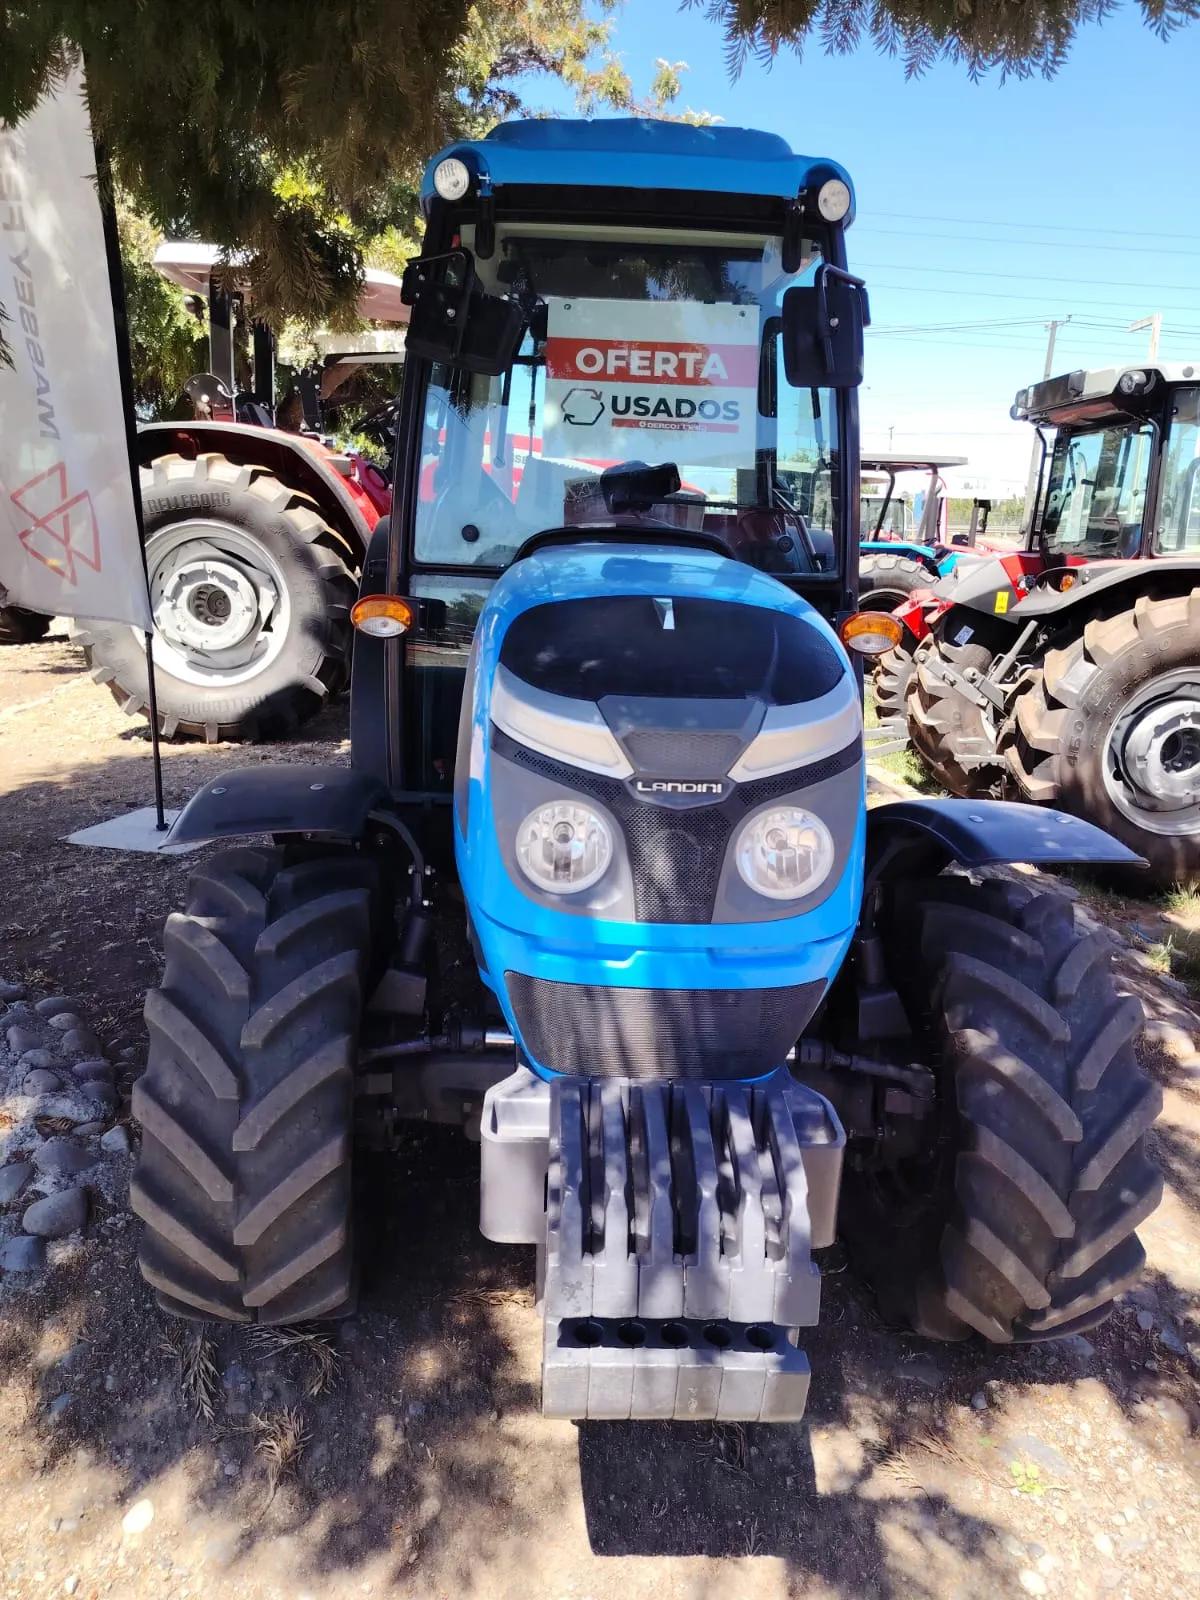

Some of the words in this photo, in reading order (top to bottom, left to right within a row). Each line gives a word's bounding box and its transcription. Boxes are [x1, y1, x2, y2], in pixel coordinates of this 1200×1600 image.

[575, 347, 728, 379] OFERTA
[611, 395, 740, 421] USADOS
[636, 781, 722, 793] LANDINI
